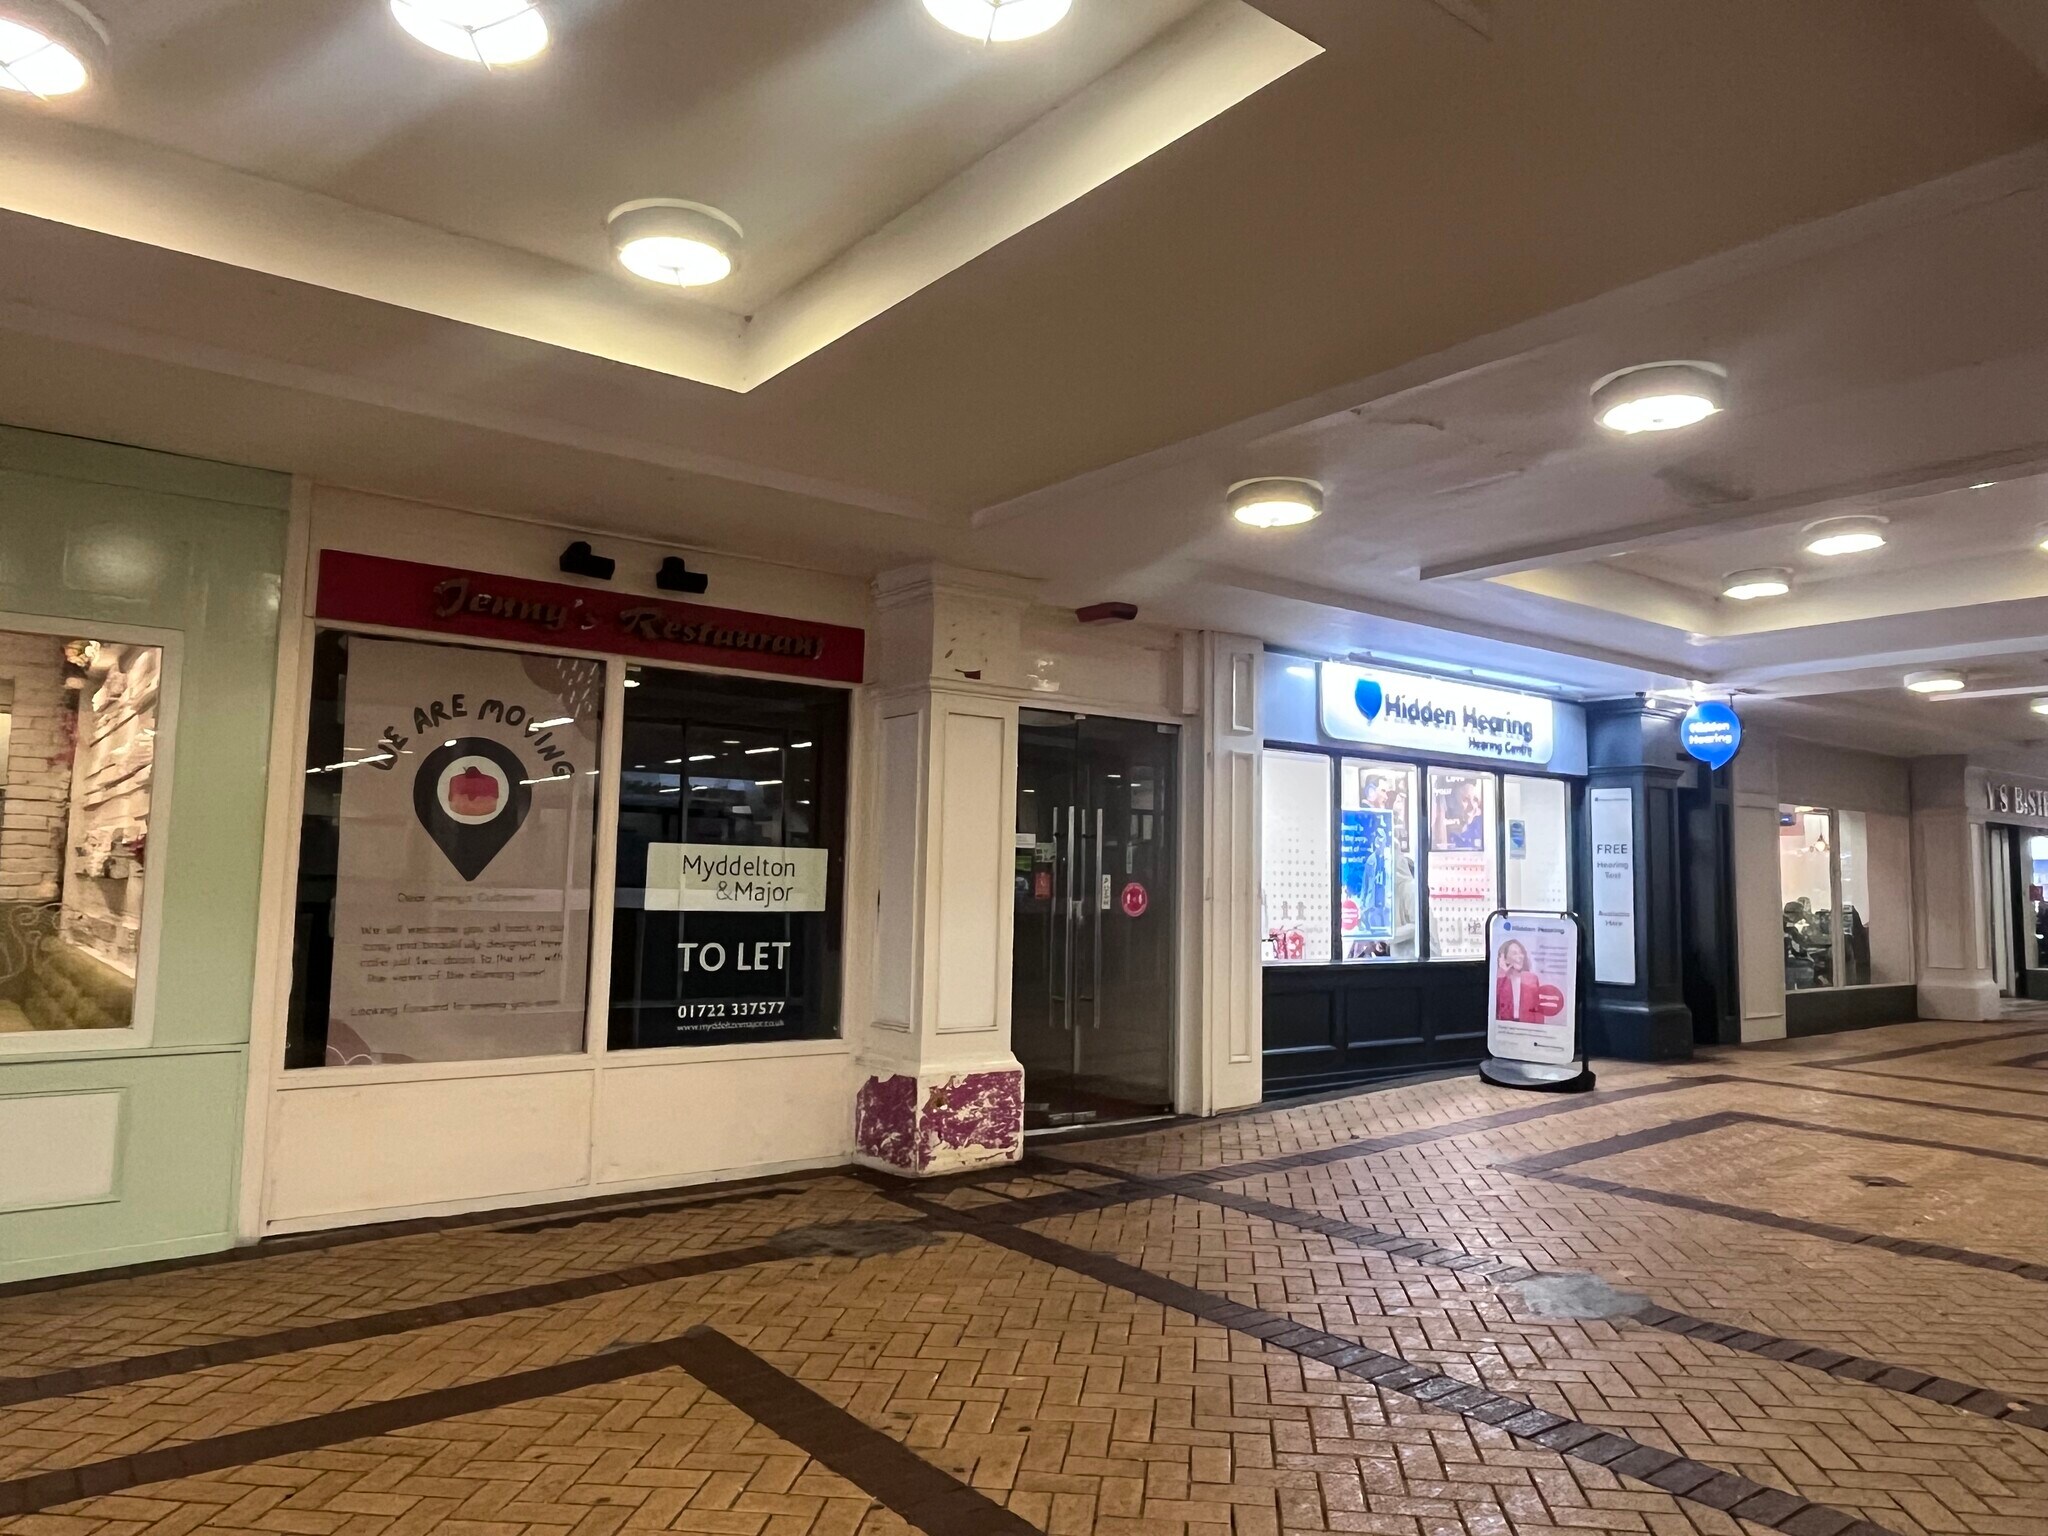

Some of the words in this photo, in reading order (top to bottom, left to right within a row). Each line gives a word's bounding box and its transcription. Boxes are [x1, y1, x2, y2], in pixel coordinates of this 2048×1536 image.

[432, 577, 601, 631] Jenny's
[619, 605, 825, 661] Restaurant
[413, 693, 468, 735] ARE
[1384, 693, 1457, 727] Hidden
[1462, 704, 1534, 742] Hearing
[1596, 843, 1629, 855] FREE
[682, 854, 796, 882] Myddelton
[715, 880, 795, 908] &Major
[677, 942, 727, 973] TO
[737, 941, 792, 972] LET
[677, 1003, 726, 1019] 01722
[731, 1001, 786, 1016] 337577
